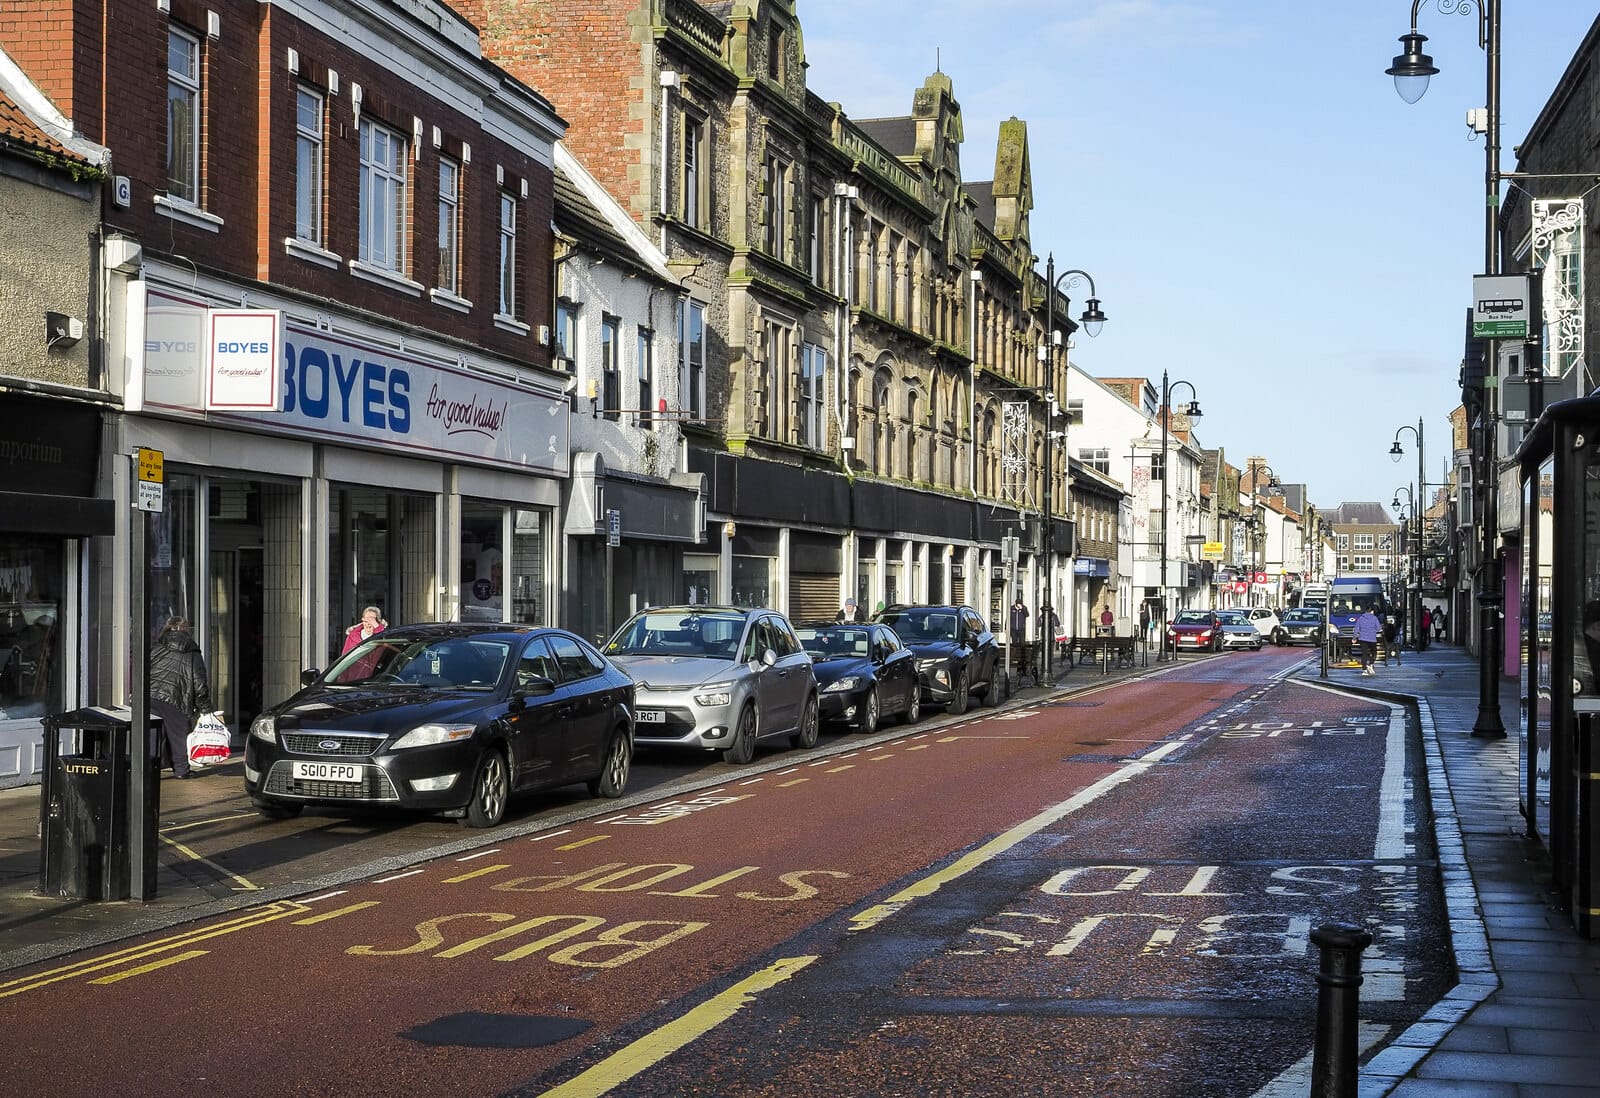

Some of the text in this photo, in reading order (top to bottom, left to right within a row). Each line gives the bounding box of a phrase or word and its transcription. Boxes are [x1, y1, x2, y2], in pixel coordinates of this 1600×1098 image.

[218, 342, 269, 353] BOYES
[228, 367, 246, 377] good
[426, 383, 508, 432] for good value!
[640, 712, 659, 721] RGT
[66, 764, 99, 775] LITTER
[301, 763, 354, 779] SG10 FPO
[490, 862, 851, 901] STOP
[344, 912, 710, 969] BUS
